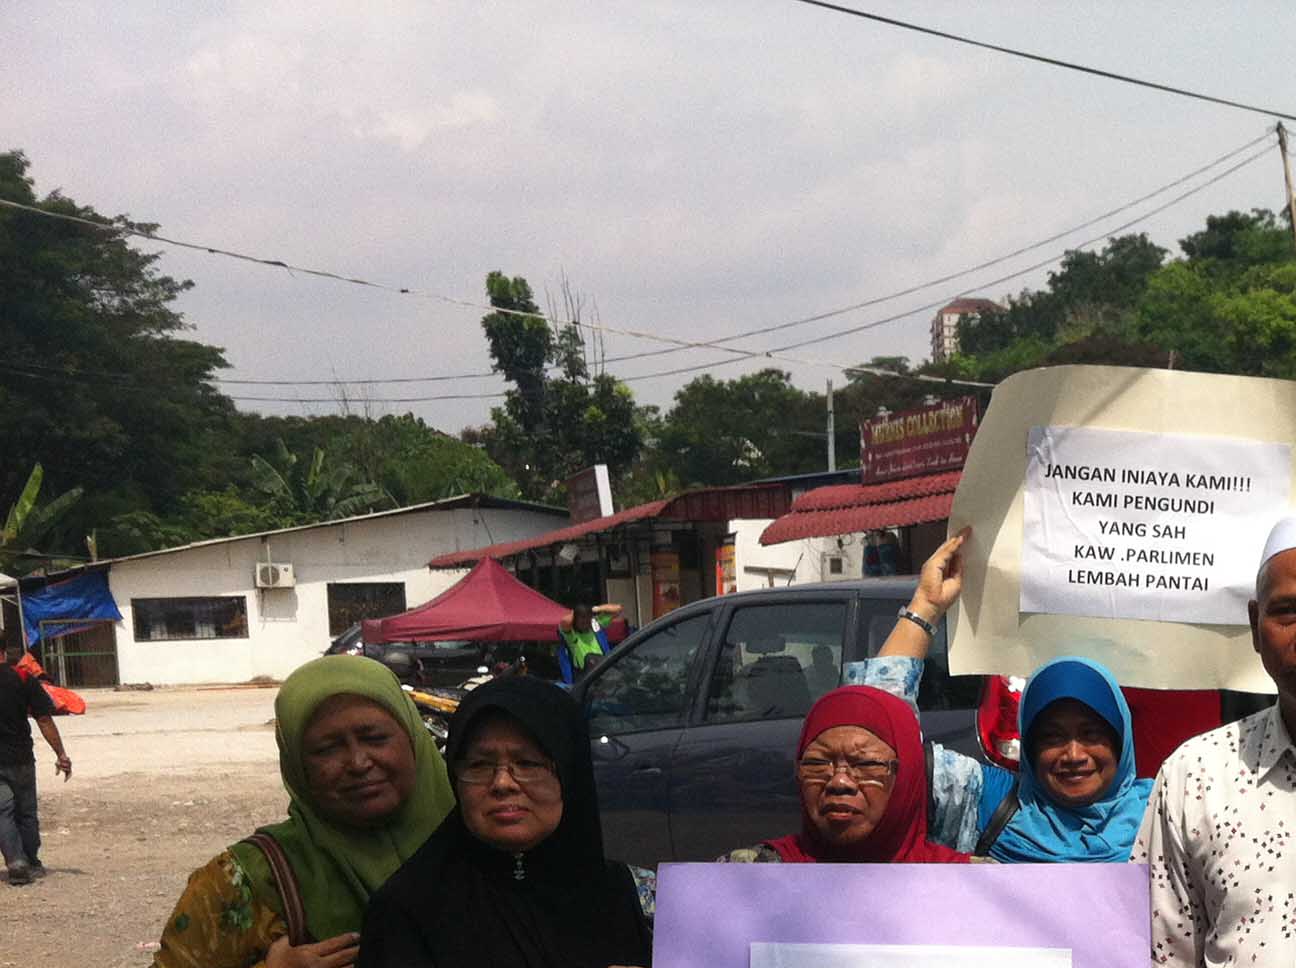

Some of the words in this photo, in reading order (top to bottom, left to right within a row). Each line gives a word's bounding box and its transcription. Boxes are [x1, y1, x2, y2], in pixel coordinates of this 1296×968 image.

[1044, 464, 1116, 482] JANGAN
[1122, 470, 1180, 487] INIAYA
[1186, 474, 1250, 492] KAMI!!!
[1072, 492, 1117, 508] KAMI
[1124, 496, 1214, 514] PENGUNDI
[1099, 521, 1146, 538] YANG
[1152, 524, 1186, 539] SAH
[1074, 545, 1115, 560] KAW
[1068, 570, 1139, 587] LEMBAH
[1146, 574, 1208, 591] PANTAI
